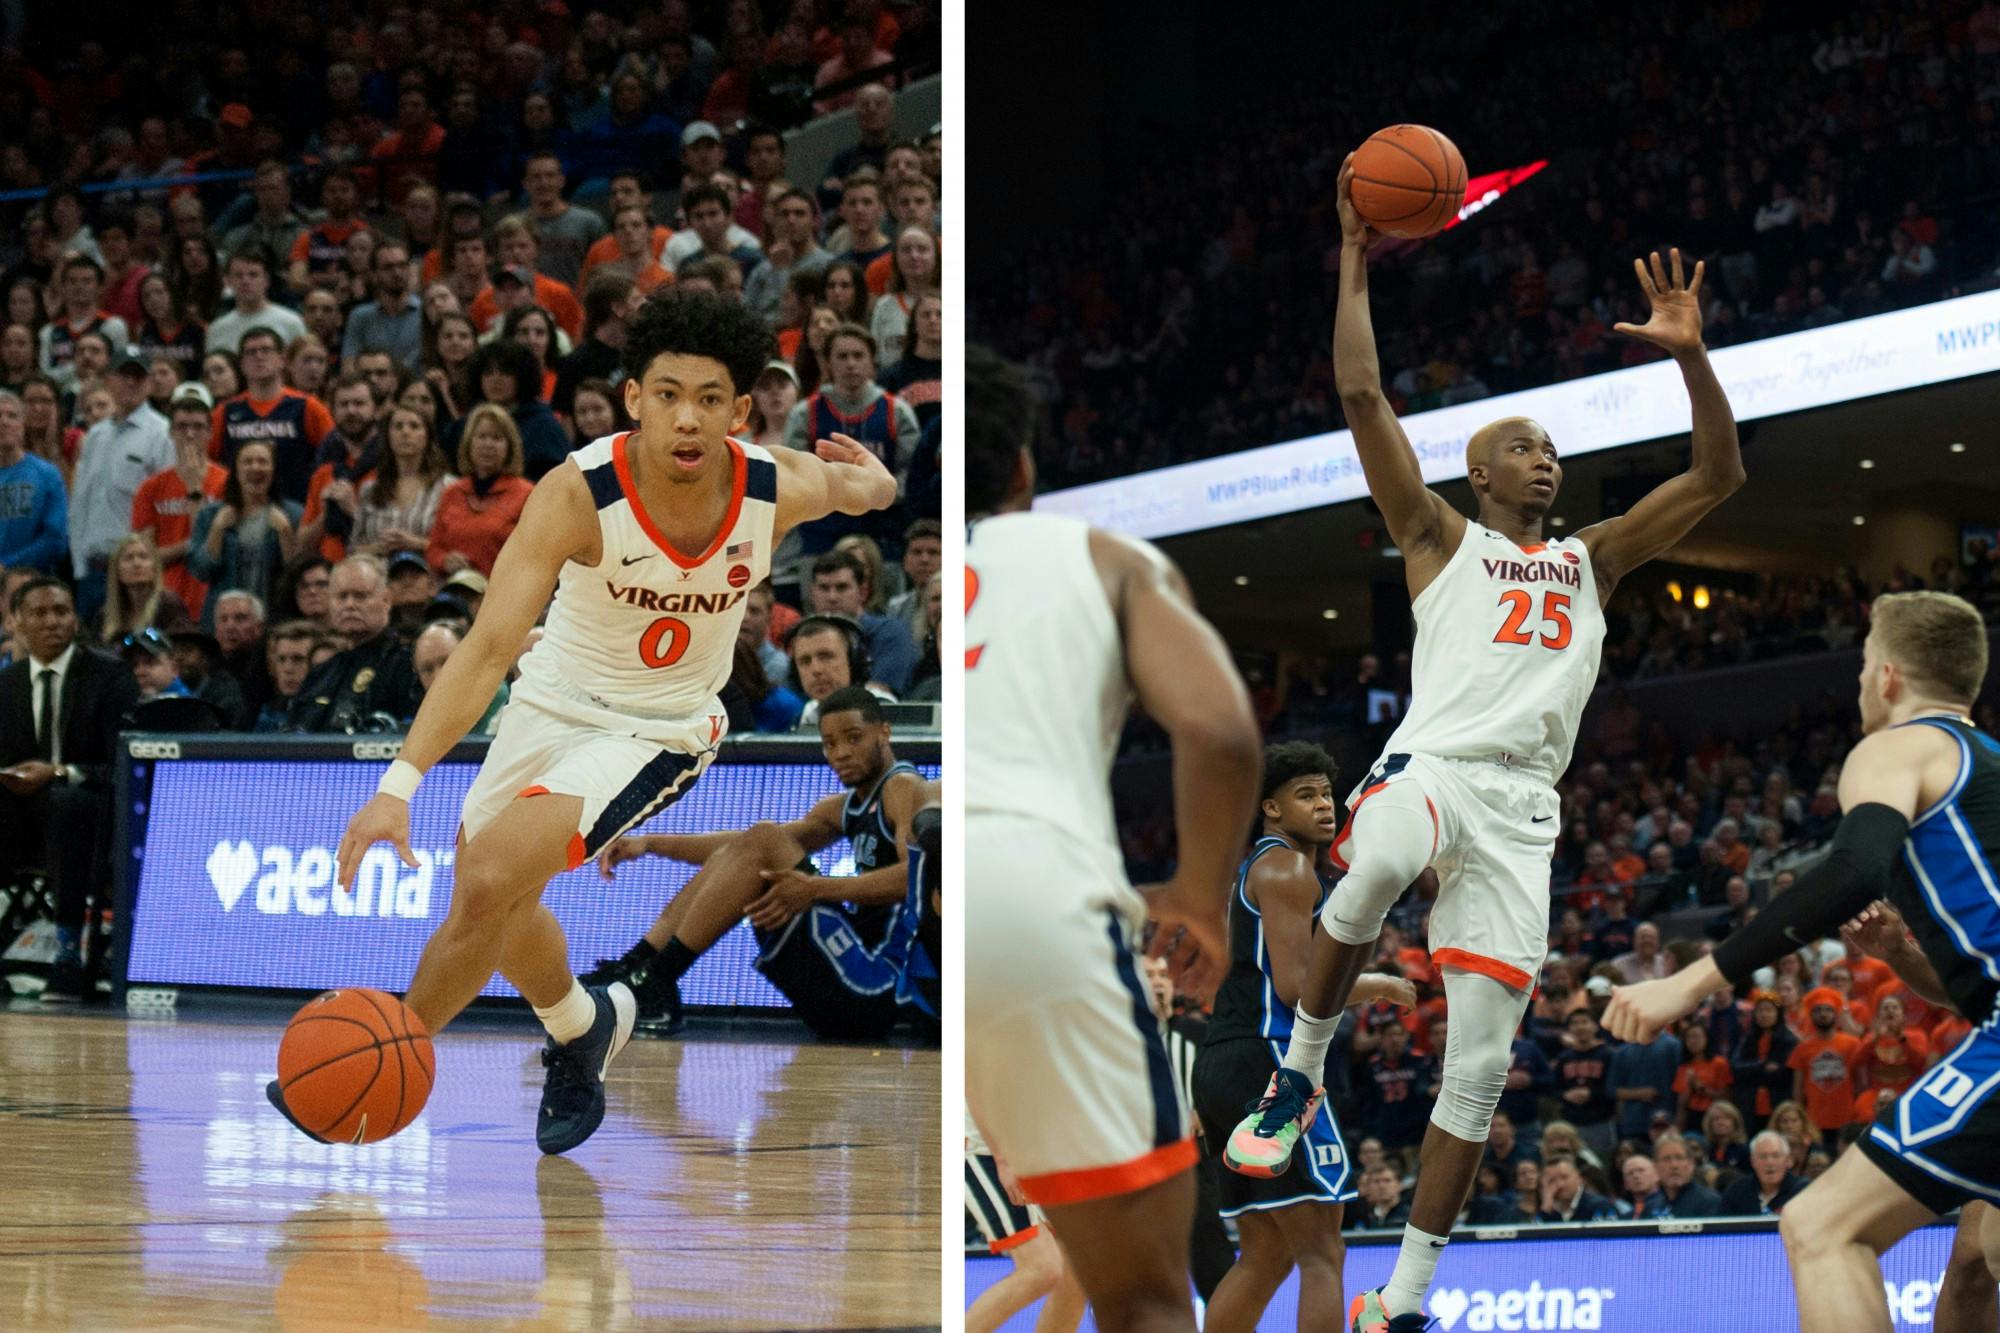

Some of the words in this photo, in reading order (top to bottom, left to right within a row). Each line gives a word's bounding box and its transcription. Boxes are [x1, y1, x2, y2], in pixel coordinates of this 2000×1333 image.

[1936, 320, 2000, 355] MWP
[1788, 339, 1898, 387] Together
[226, 419, 297, 439] VIRGINIA
[1481, 558, 1581, 591] VIRGINIA
[1492, 589, 1573, 651] 25
[639, 616, 690, 669] 0
[128, 741, 180, 759] GEICO
[1314, 1144, 1342, 1167] D
[1466, 1279, 1603, 1332] aetna
